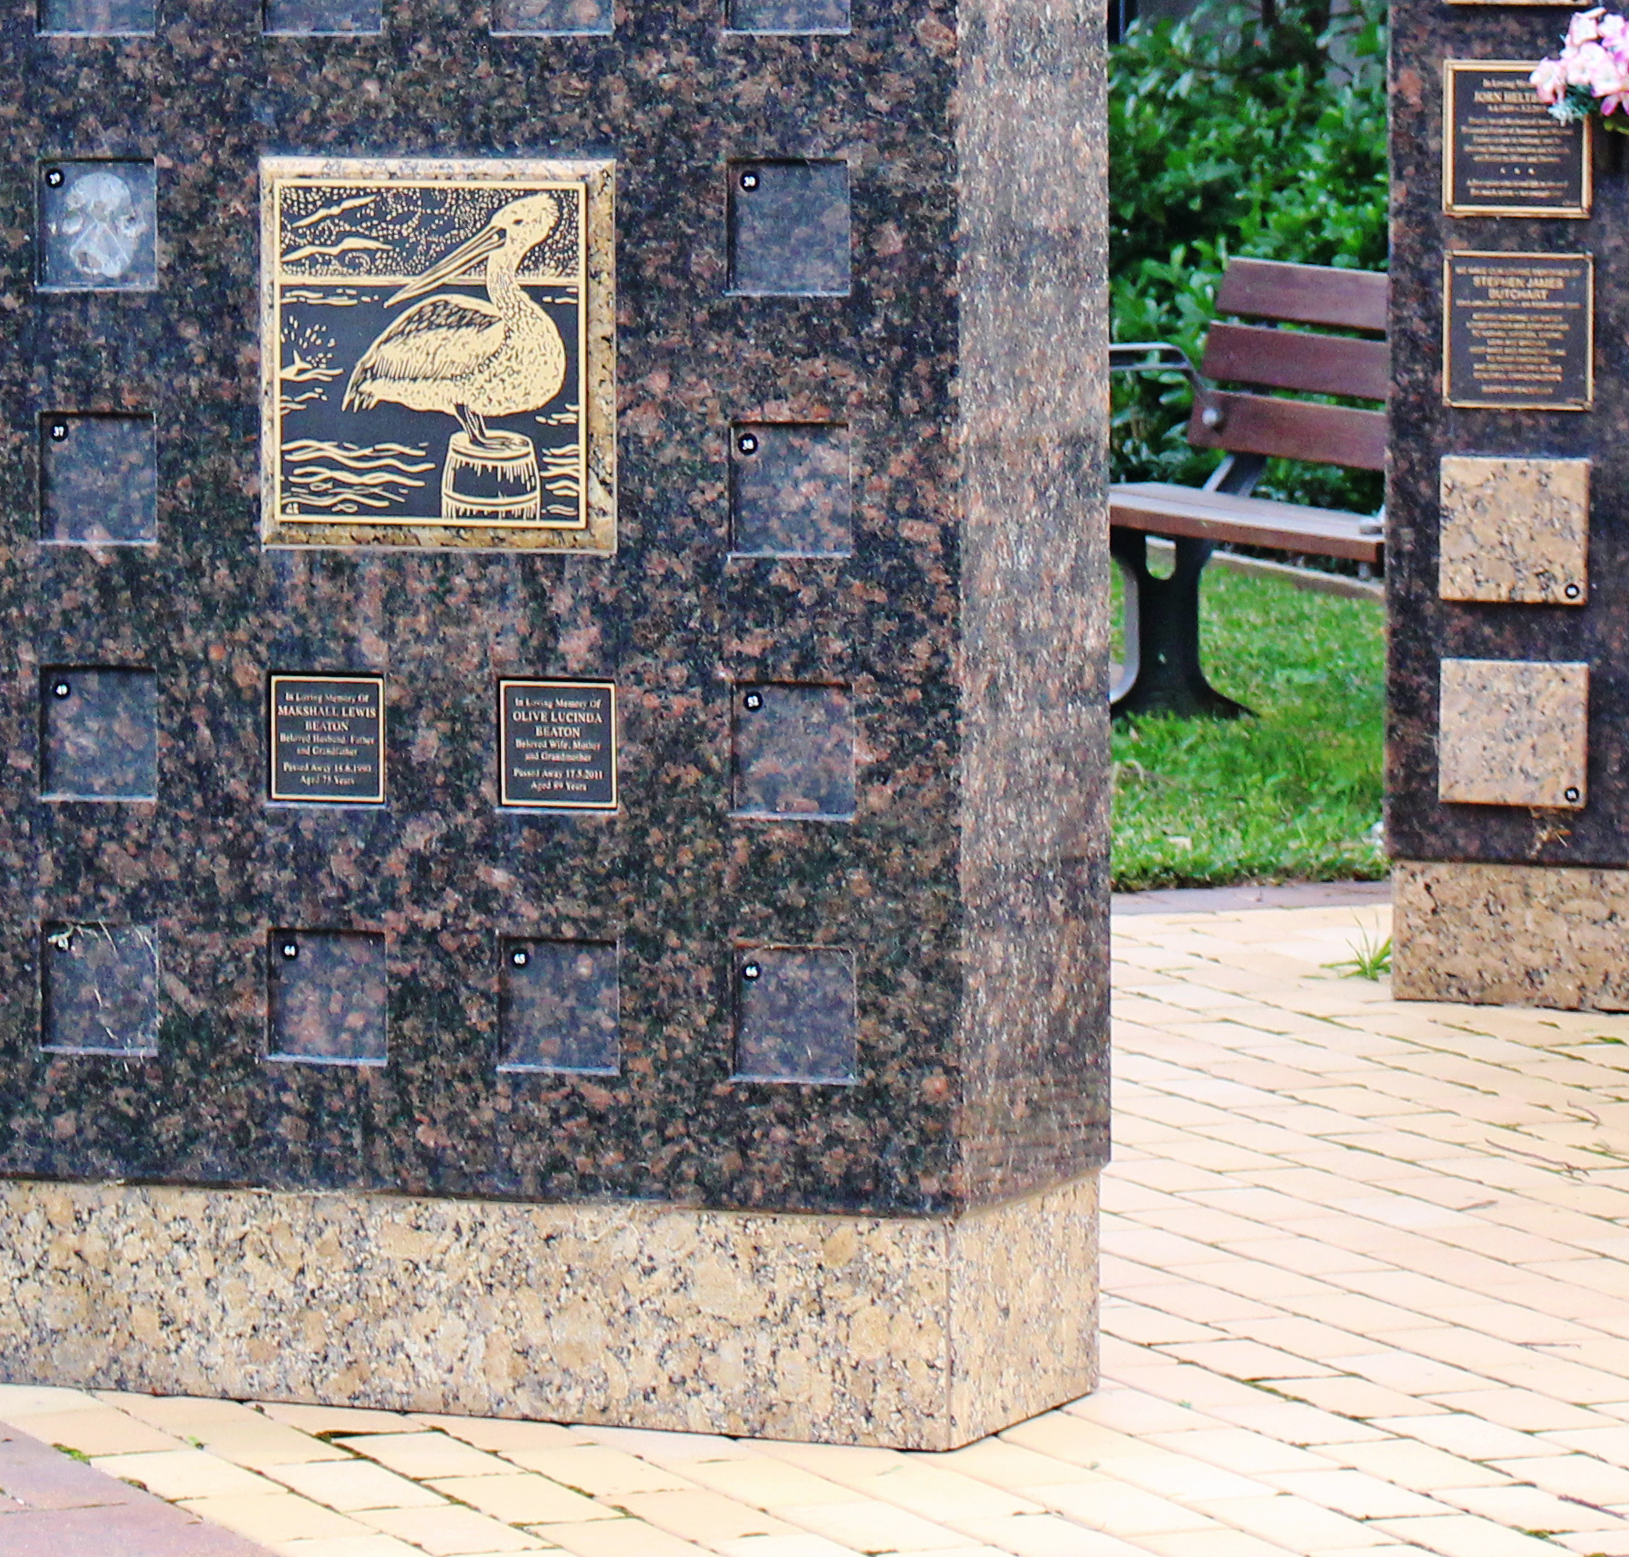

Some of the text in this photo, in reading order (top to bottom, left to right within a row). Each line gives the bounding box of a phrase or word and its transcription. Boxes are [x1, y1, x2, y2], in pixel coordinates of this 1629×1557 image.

[278, 705, 376, 718] MARSHALL LEWIS
[512, 710, 604, 724] OLIVE LUCINDA
[304, 720, 350, 732] BEATON
[535, 725, 581, 738] BEATON
